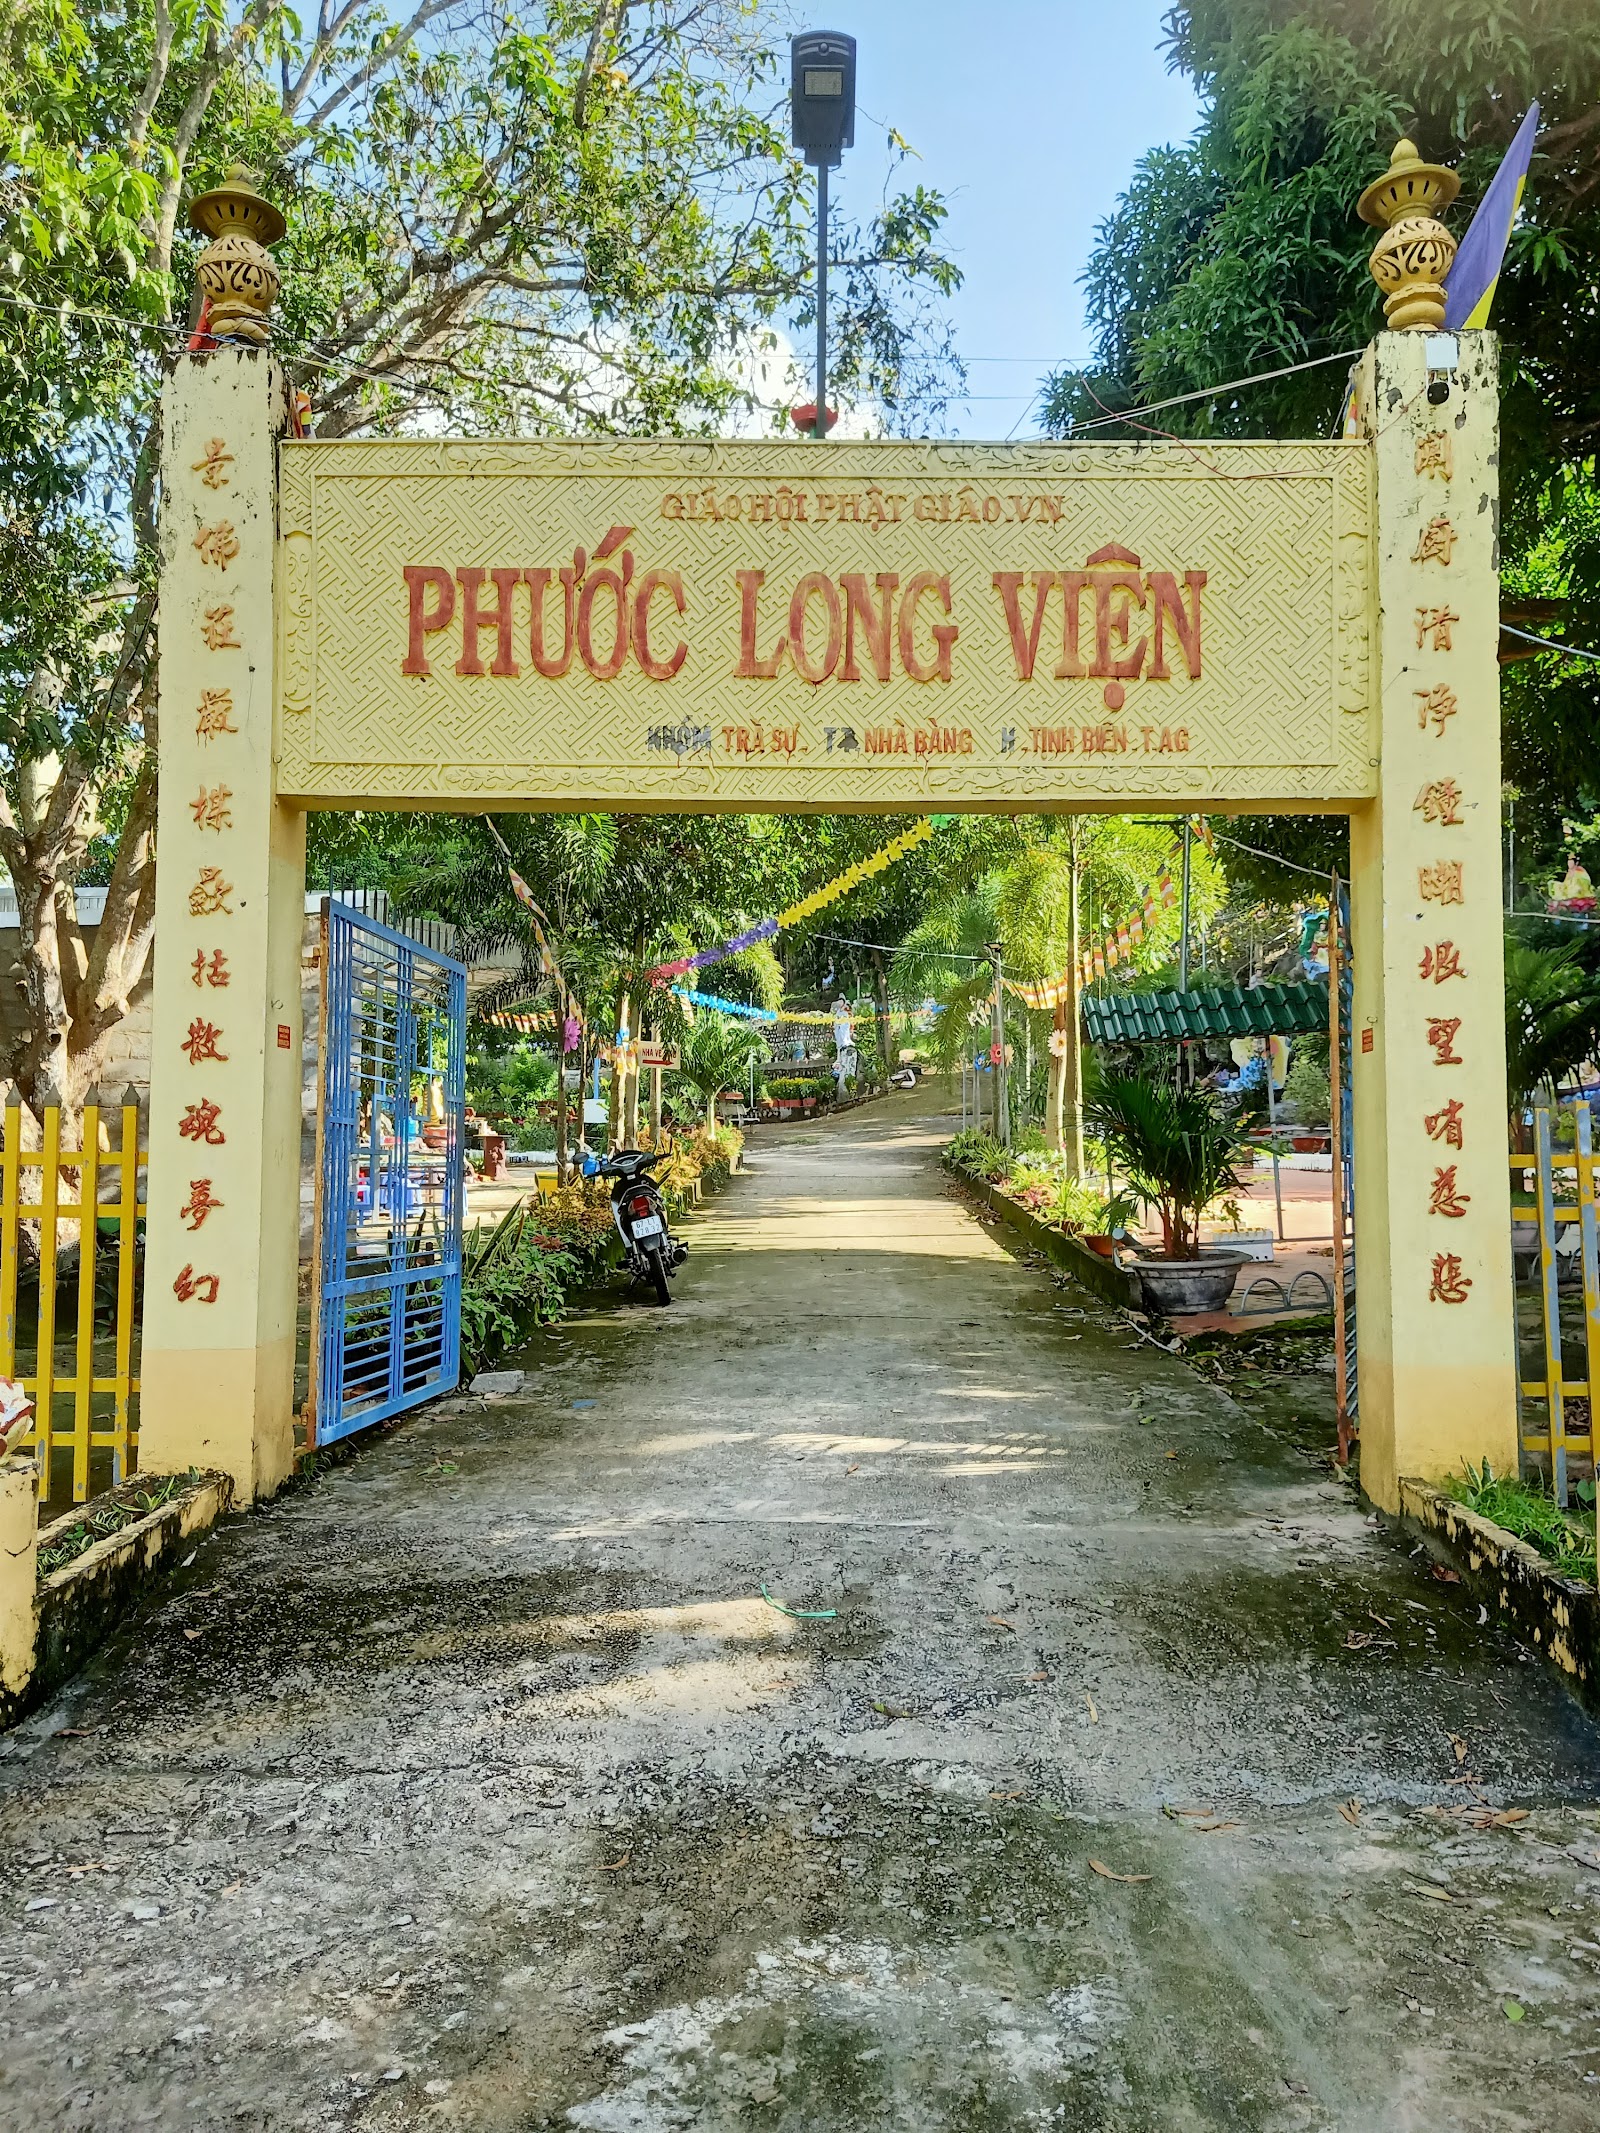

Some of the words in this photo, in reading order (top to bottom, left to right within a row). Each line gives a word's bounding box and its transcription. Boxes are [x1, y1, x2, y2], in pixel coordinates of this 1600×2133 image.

[660, 485, 742, 522] GIÁO
[748, 485, 808, 531] HỘI
[814, 485, 907, 531] PHẬT
[402, 526, 688, 681] PHƯỚC
[733, 570, 959, 683] LONG
[992, 541, 1207, 711] VIỆN
[722, 719, 765, 753] TRÀ
[864, 718, 908, 753] NHÀ
[914, 717, 972, 754] BÀNG
